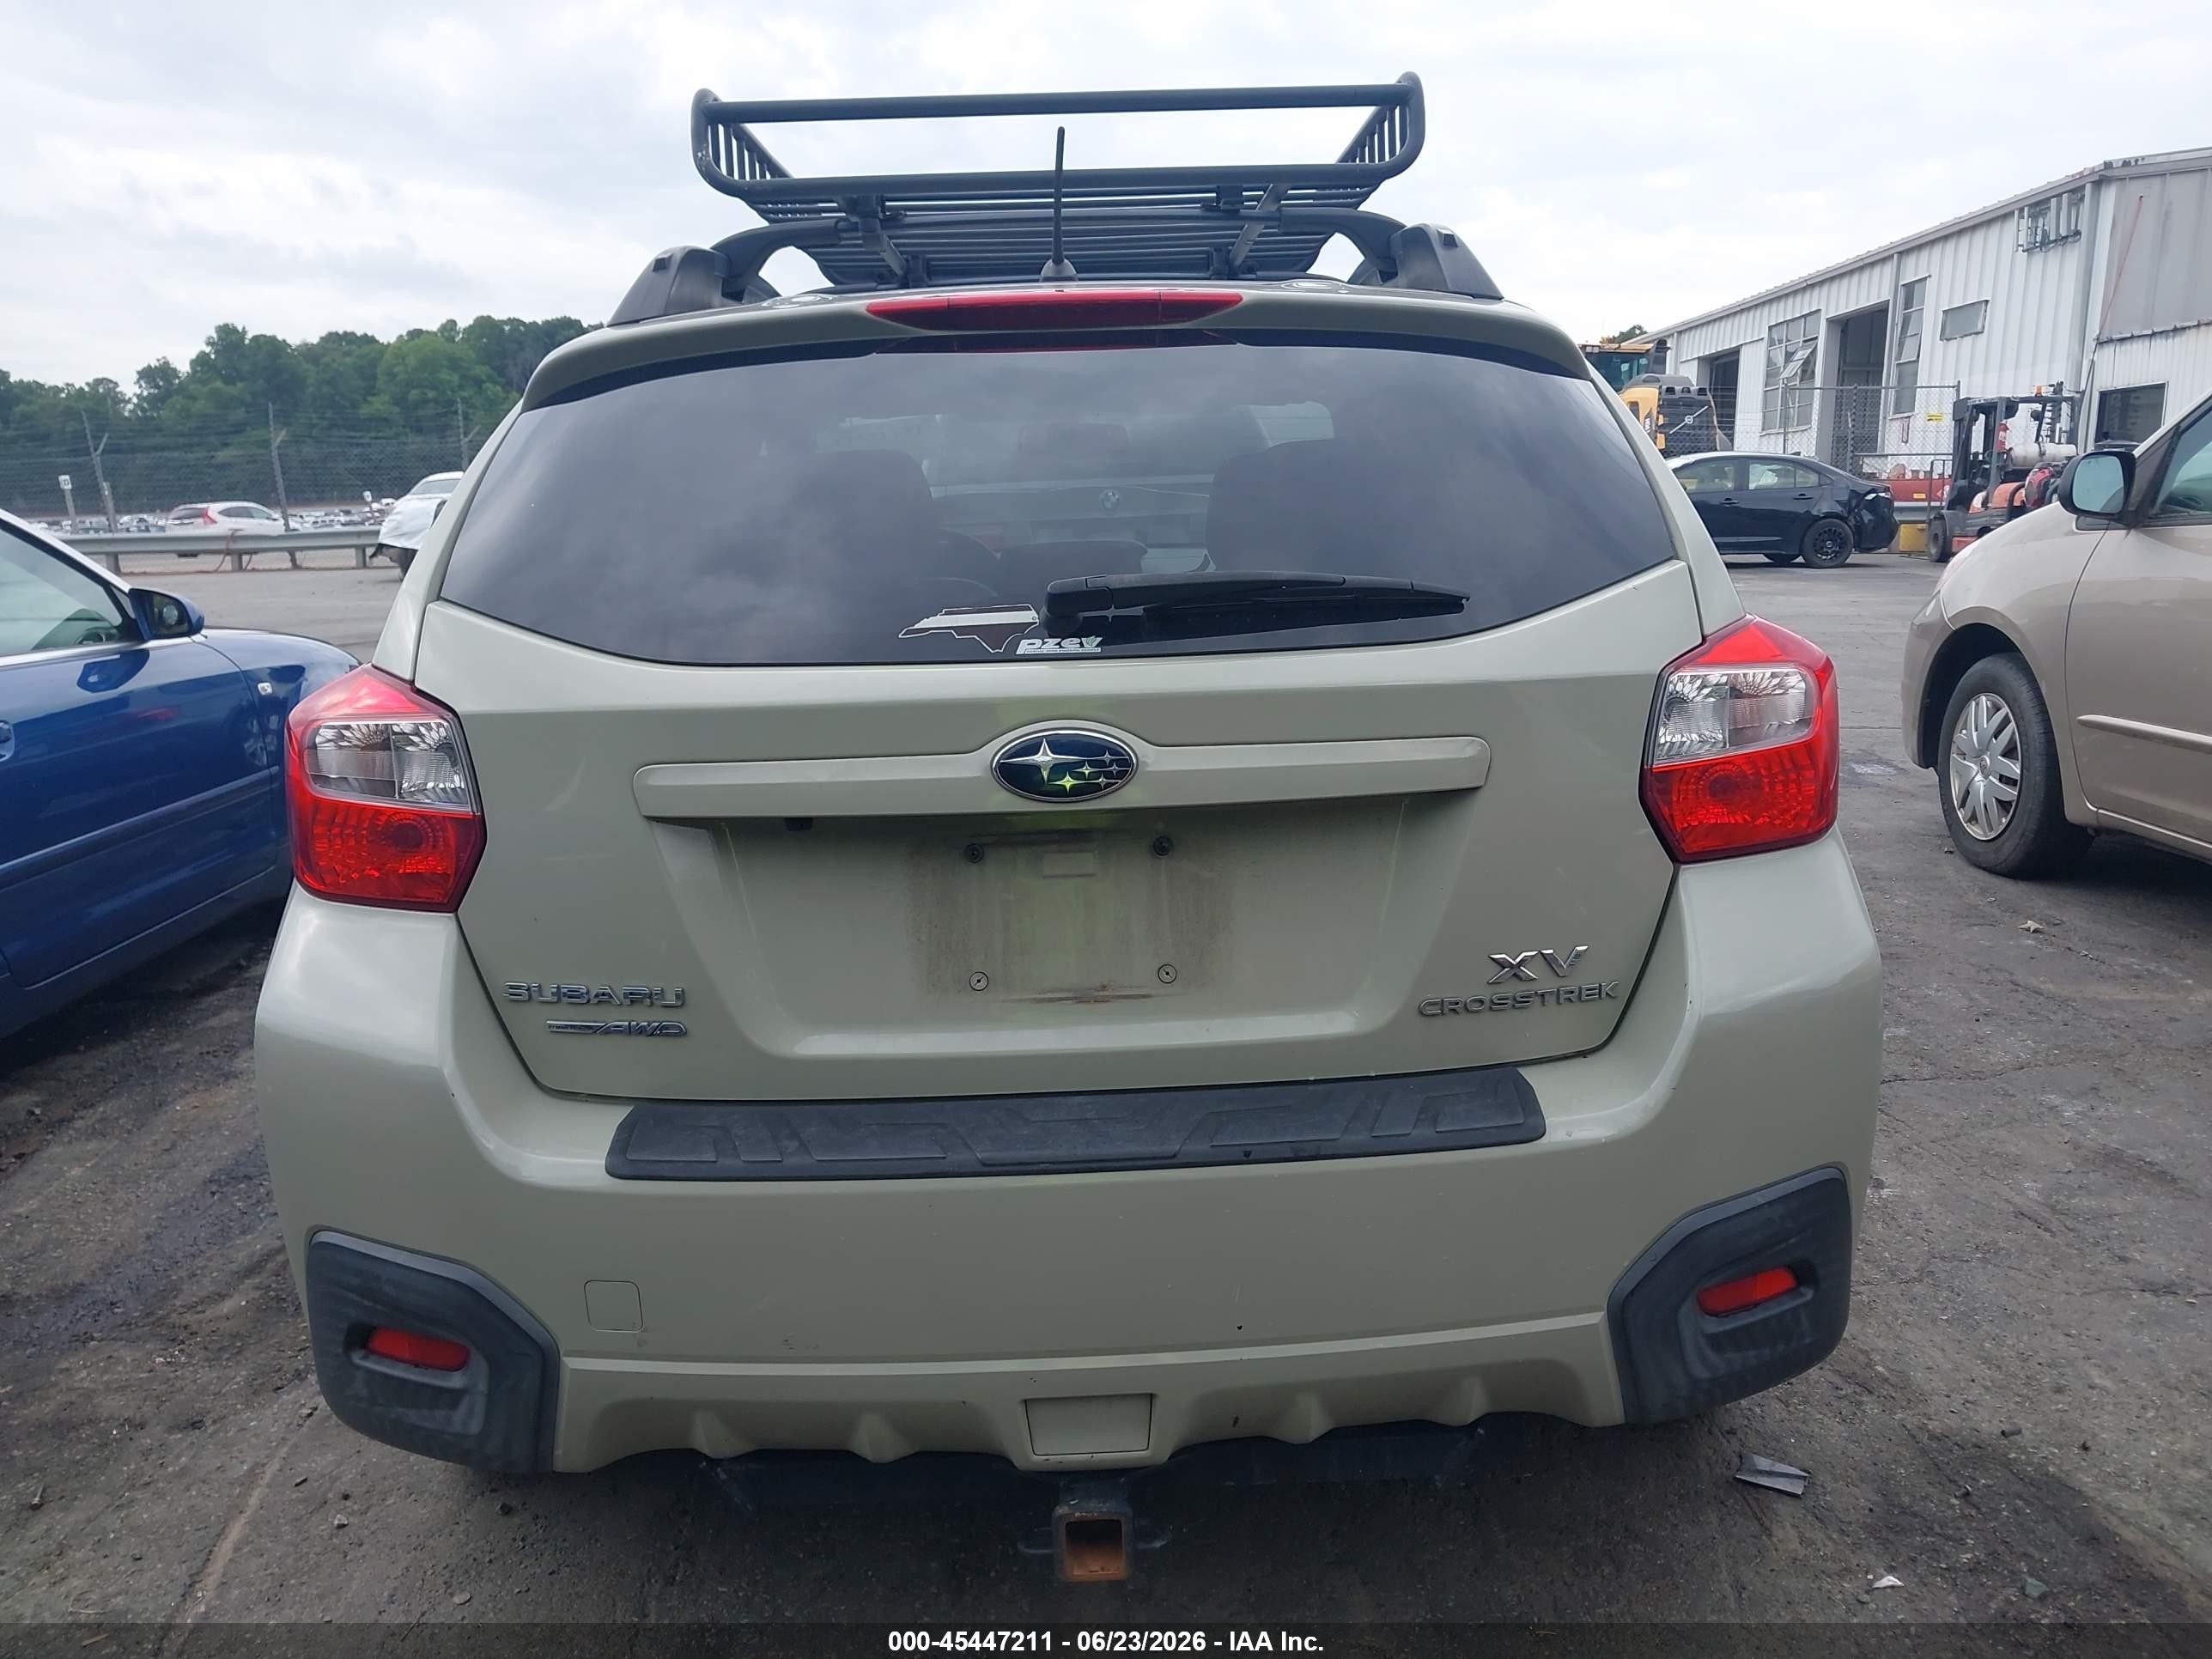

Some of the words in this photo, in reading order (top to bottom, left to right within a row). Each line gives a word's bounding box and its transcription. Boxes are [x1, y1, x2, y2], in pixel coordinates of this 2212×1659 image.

[1487, 945, 1589, 984] XV
[503, 981, 684, 1008] SUBARU
[1419, 981, 1620, 1017] CROSSTREK
[597, 1020, 688, 1037] AWD
